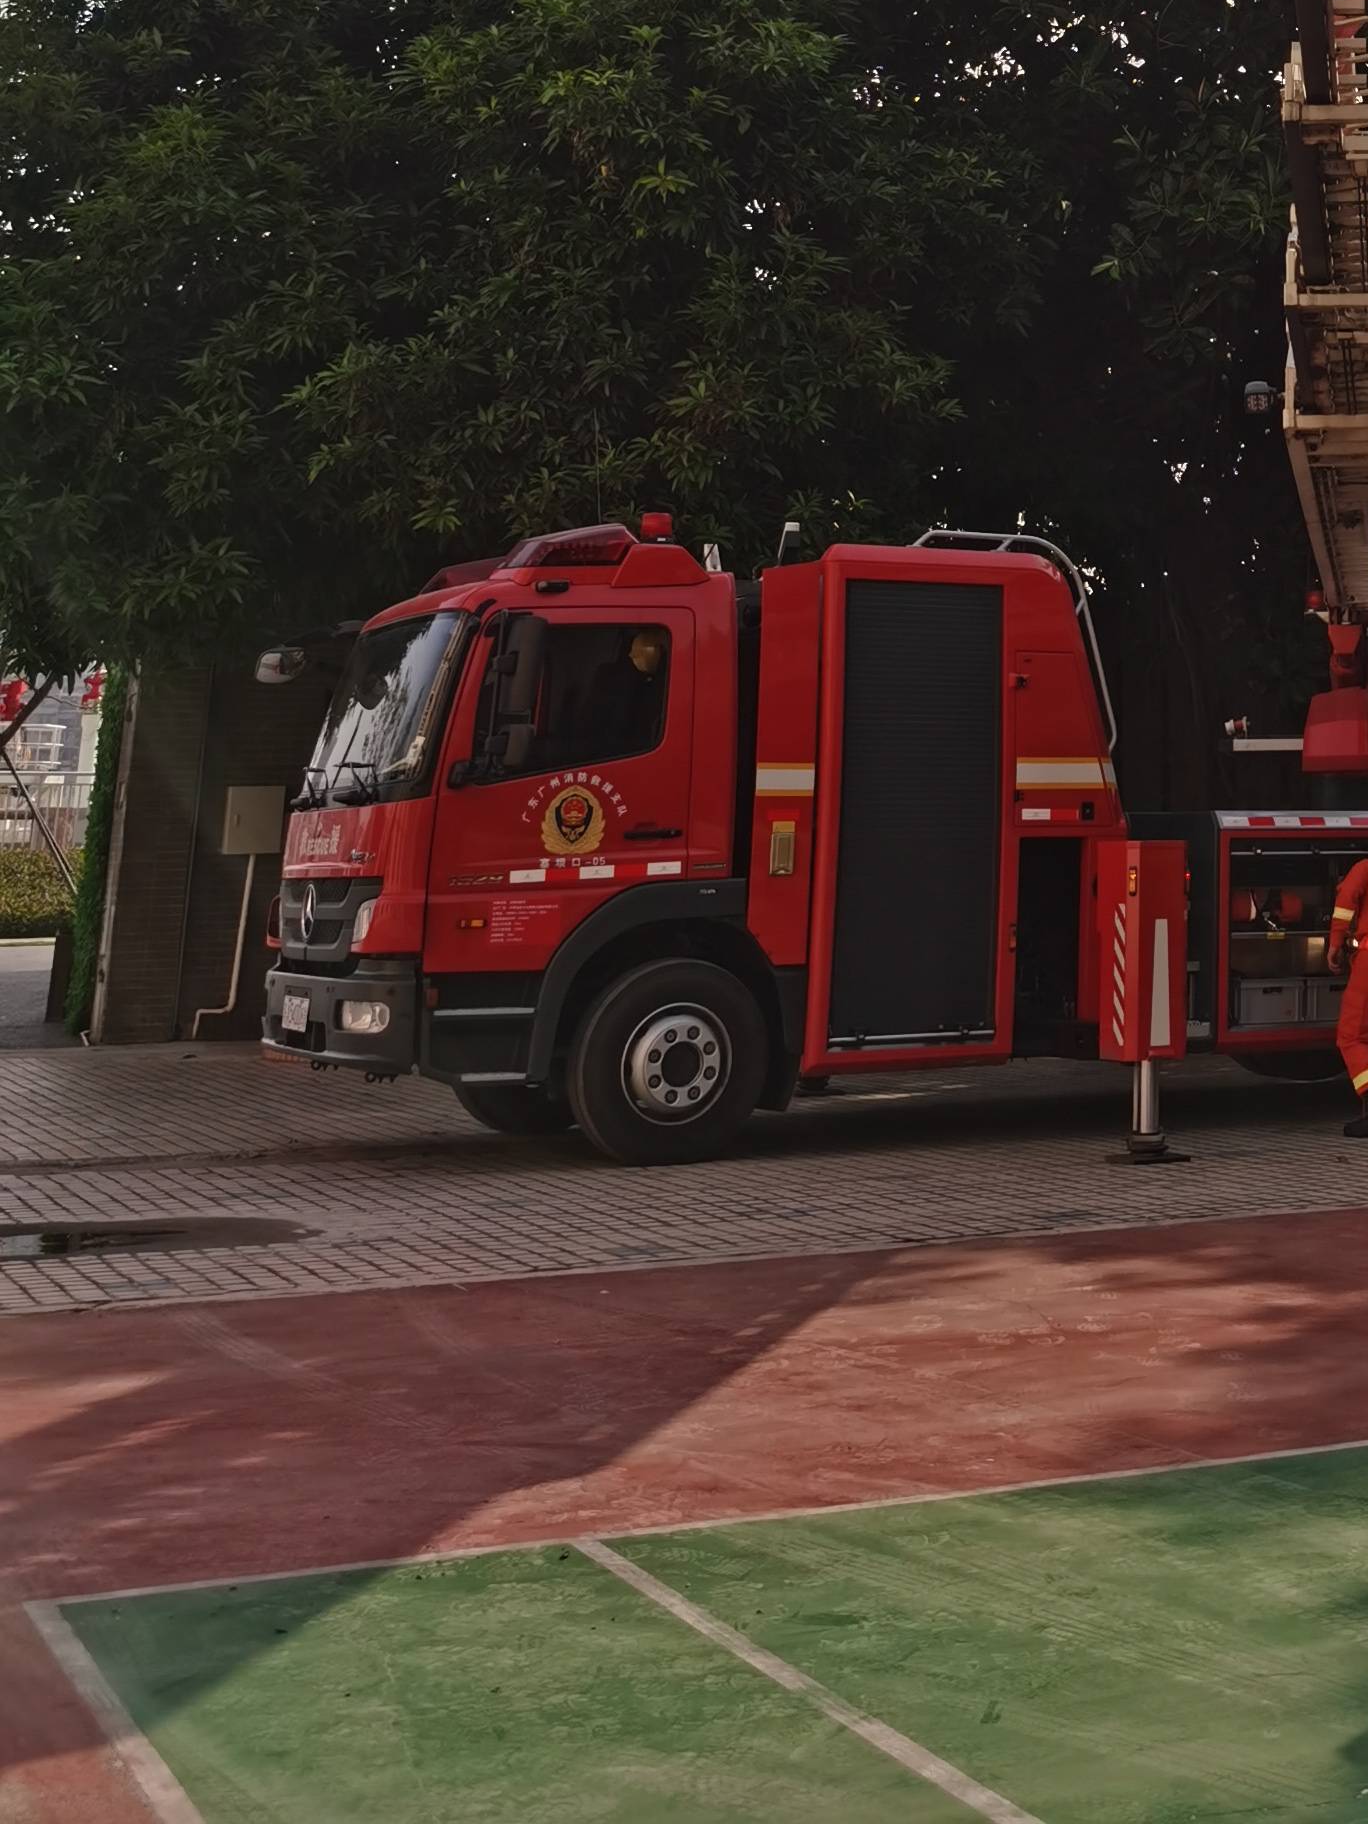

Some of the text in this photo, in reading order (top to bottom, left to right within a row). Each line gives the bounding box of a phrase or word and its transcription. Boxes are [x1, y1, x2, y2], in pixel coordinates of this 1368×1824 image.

[521, 772, 629, 823] 广东广州消防救援支队
